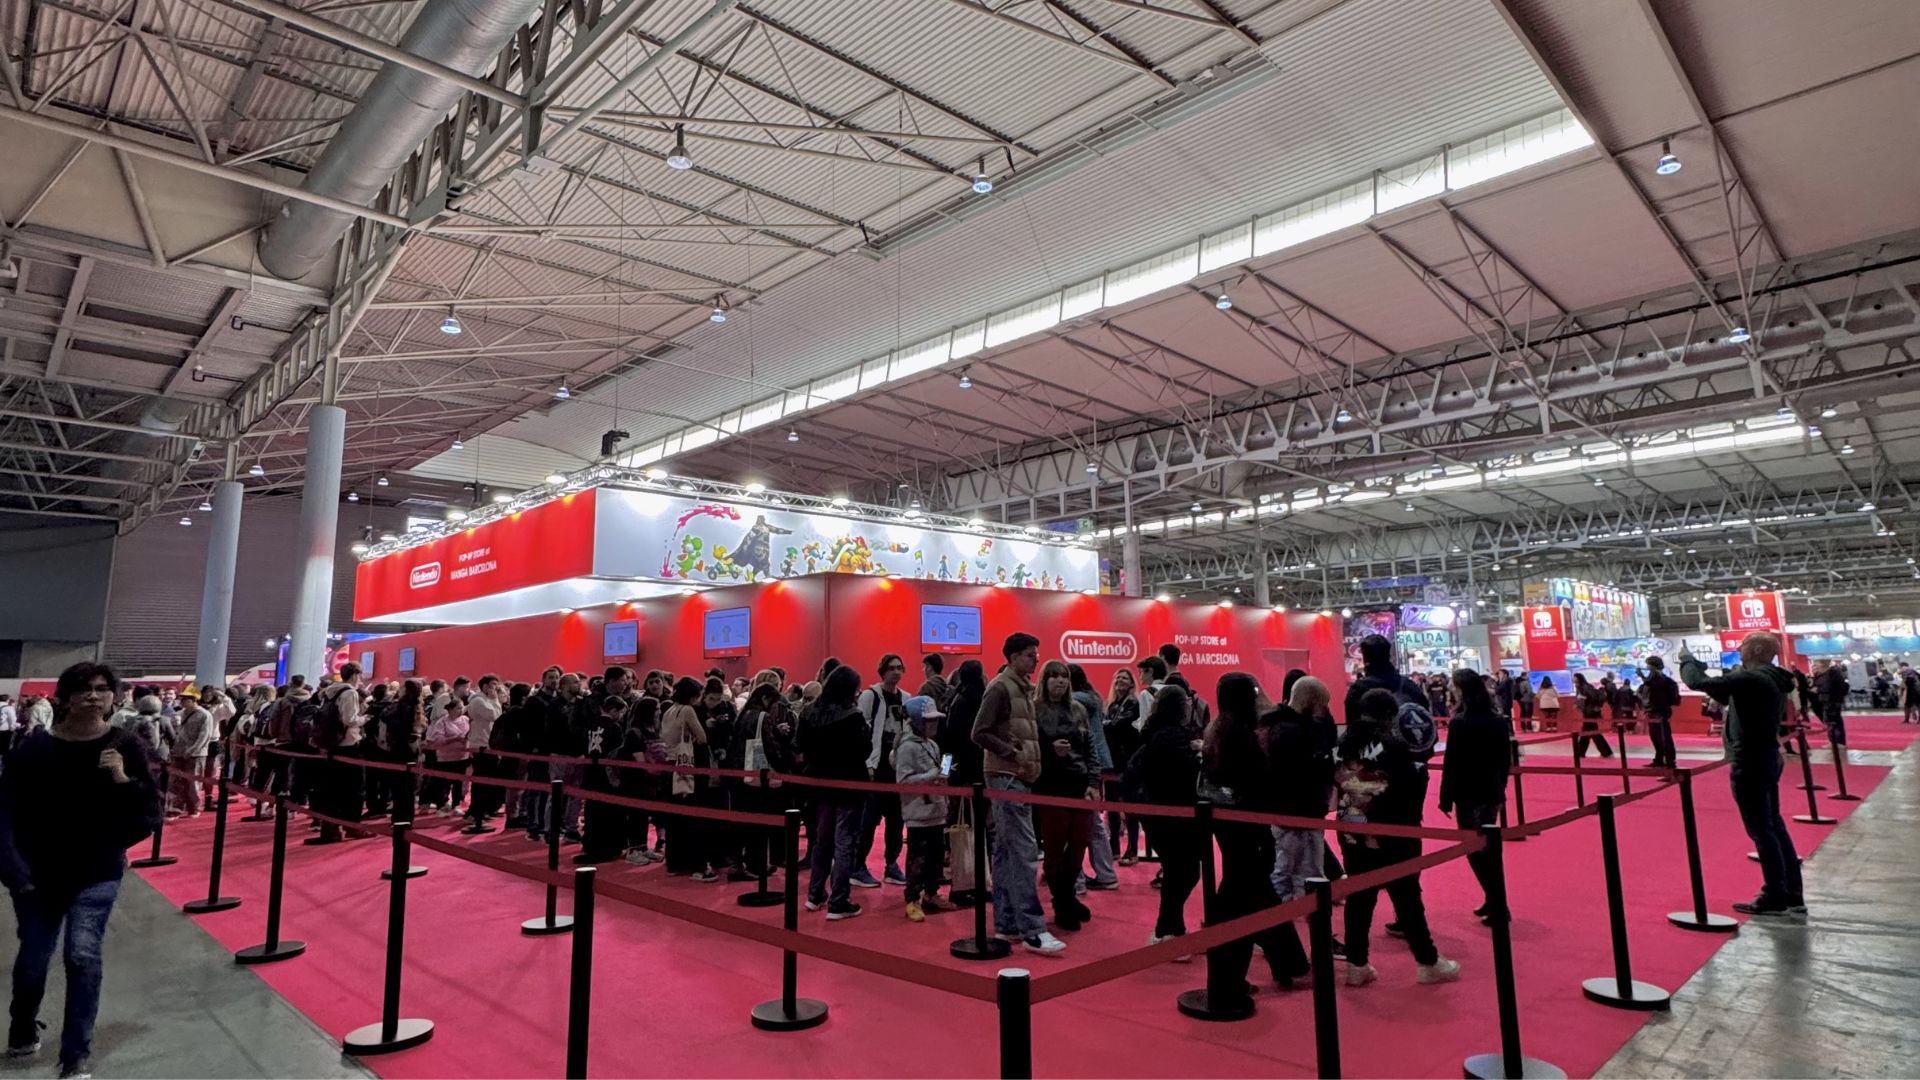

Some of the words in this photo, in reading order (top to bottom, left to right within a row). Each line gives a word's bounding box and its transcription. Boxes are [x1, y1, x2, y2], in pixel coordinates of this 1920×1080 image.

[412, 567, 438, 583] Nintendo
[450, 569, 468, 580] MANGA
[468, 560, 497, 576] BARCELONA
[1174, 634, 1199, 645] POP-UP
[1200, 636, 1219, 646] STORE
[1397, 632, 1444, 644] SALIDA
[1067, 638, 1131, 657] Nintendo
[1196, 653, 1240, 665] BARCELONA
